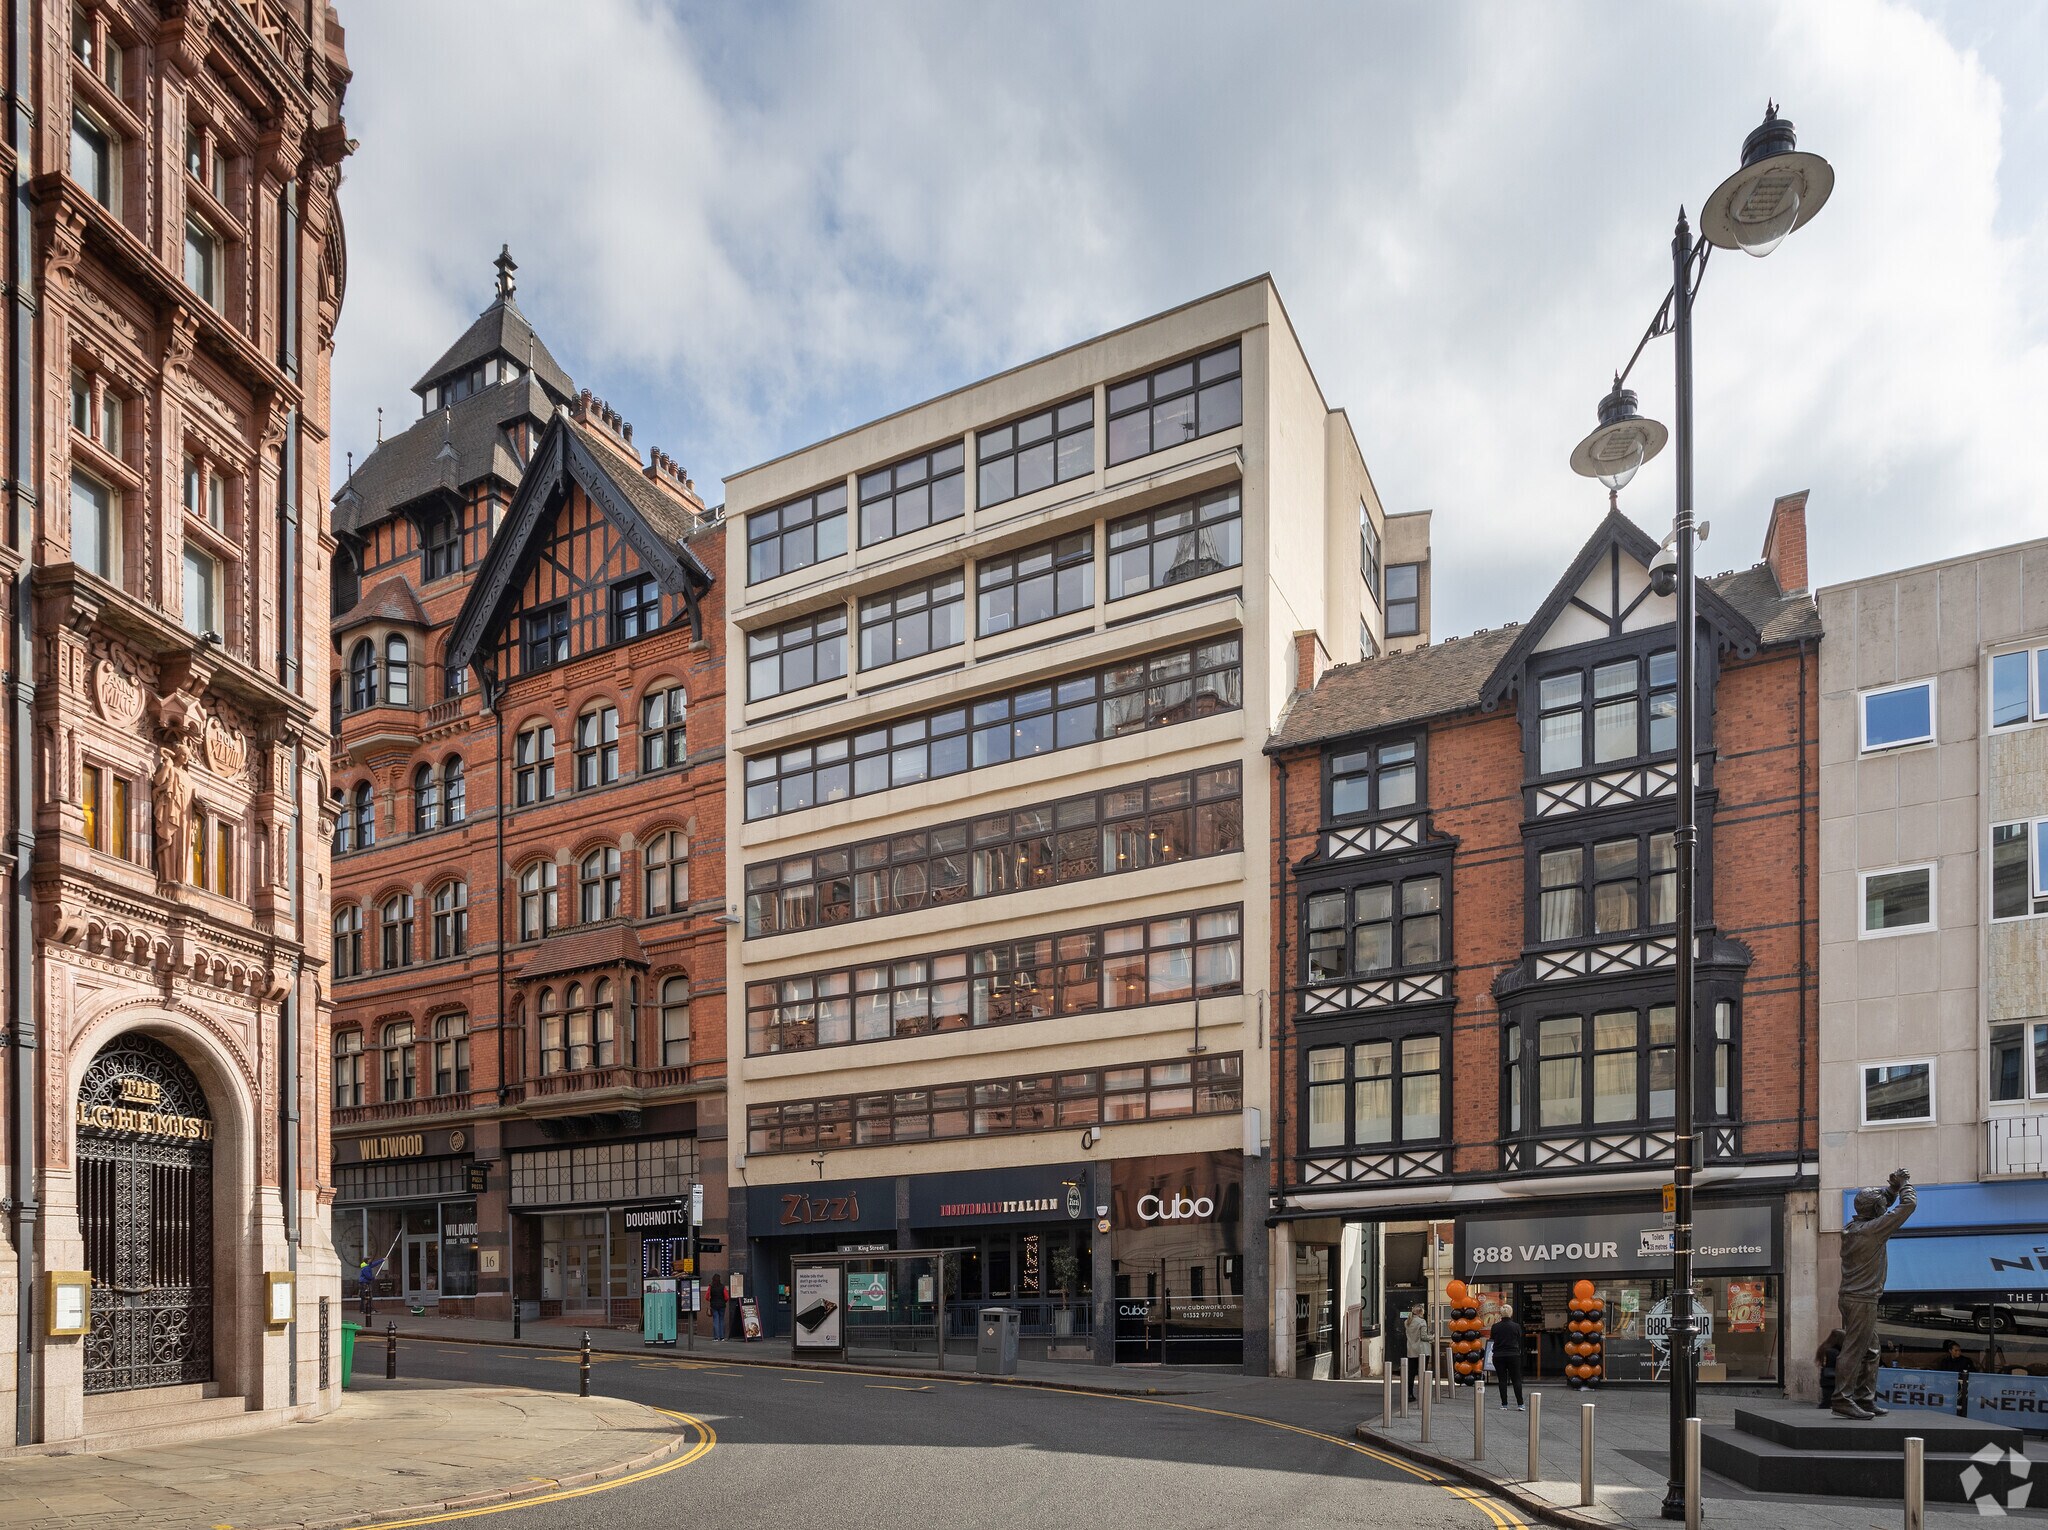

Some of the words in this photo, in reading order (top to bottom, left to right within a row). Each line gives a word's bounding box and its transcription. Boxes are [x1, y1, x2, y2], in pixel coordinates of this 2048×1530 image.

[104, 674, 135, 698] ANNO
[121, 1079, 160, 1099] THE
[76, 1101, 214, 1140] LCHEMIST
[359, 1134, 424, 1160] WILDWOOD
[780, 1190, 860, 1225] Zizzi
[1137, 1192, 1214, 1221] Cubo
[625, 1209, 684, 1228] DOUGHNOTTS
[1651, 1233, 1665, 1241] Toilets
[1472, 1246, 1513, 1263] 888
[1519, 1241, 1619, 1261] VAPOUR
[1700, 1245, 1762, 1256] Cigarettes
[485, 1256, 495, 1268] 16
[2007, 1293, 2033, 1302] THE
[1120, 1305, 1148, 1316] Cubo
[1646, 1317, 1668, 1335] 888
[1875, 1390, 1945, 1407] NERO
[1980, 1396, 2048, 1413] NERO
